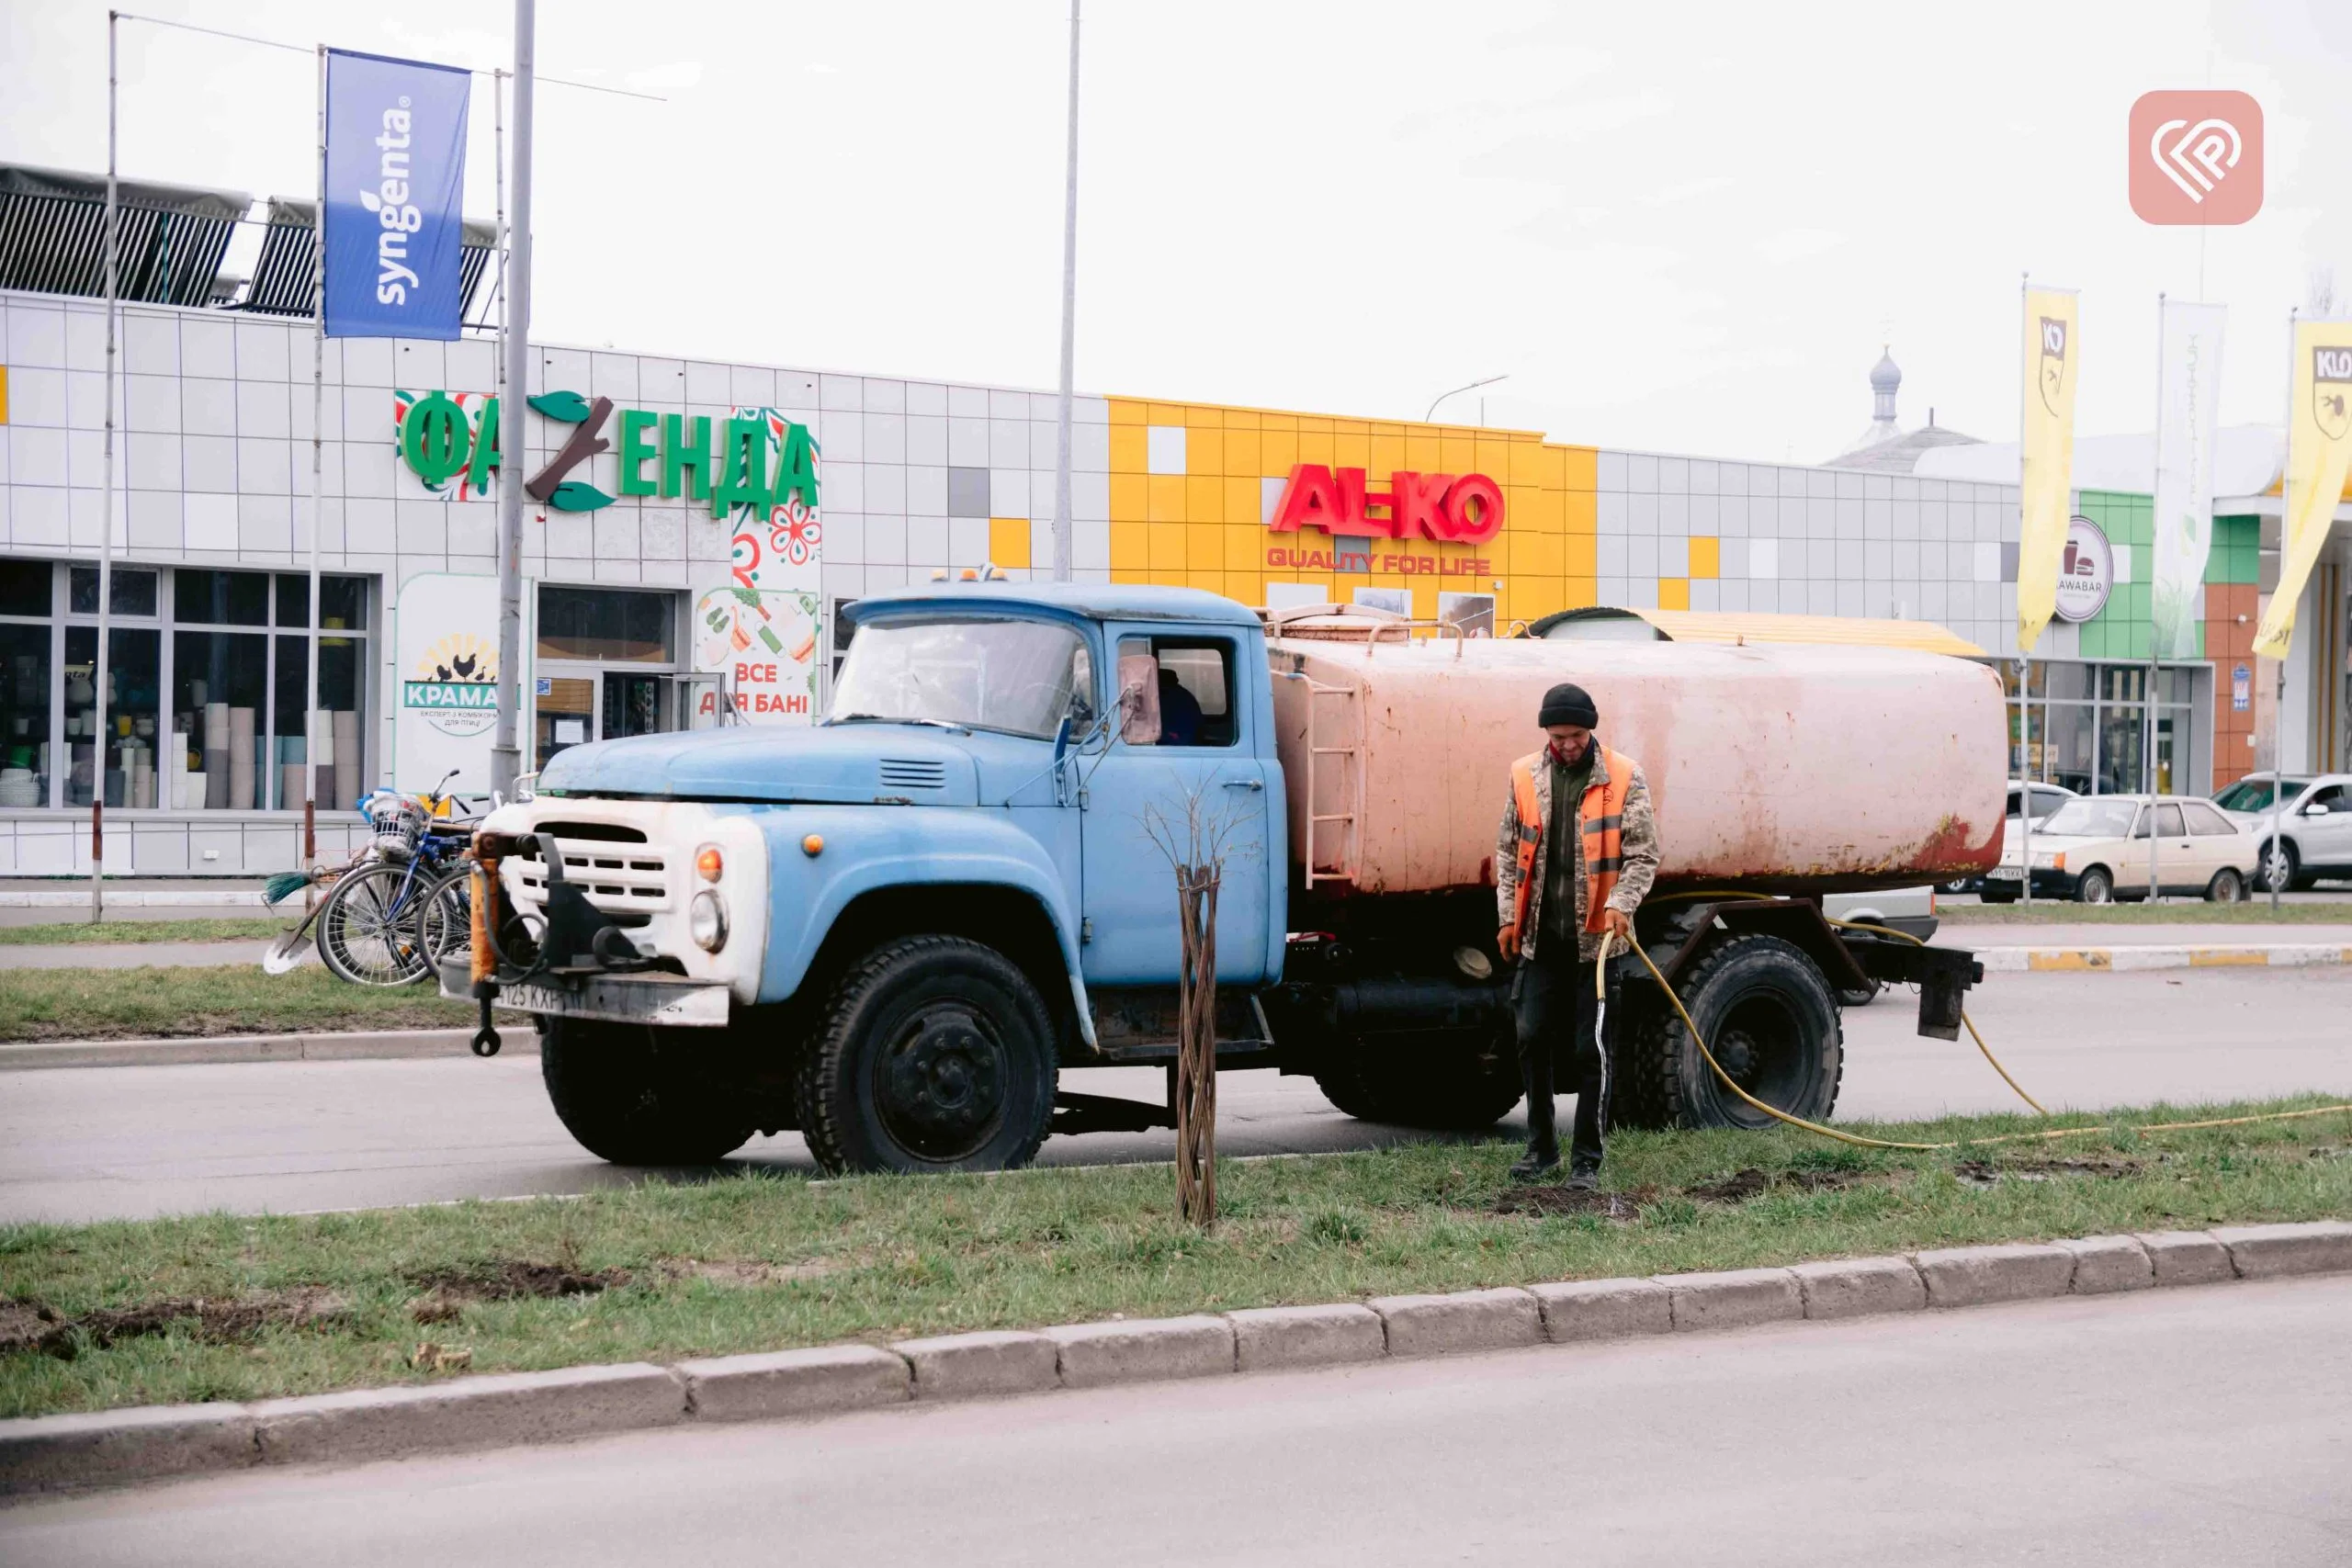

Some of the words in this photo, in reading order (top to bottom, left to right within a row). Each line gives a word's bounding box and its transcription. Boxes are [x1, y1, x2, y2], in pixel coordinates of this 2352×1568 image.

[375, 107, 422, 306] syngenta
[1267, 547, 1378, 571] QUALITY
[1383, 554, 1435, 575] FOR
[1441, 558, 1491, 576] LIFE
[2056, 580, 2102, 592] AWABAR
[735, 662, 777, 682] ВСЕ
[407, 684, 499, 706] КРАМА
[699, 691, 749, 716] ДЯ
[754, 694, 808, 714] БАНІ
